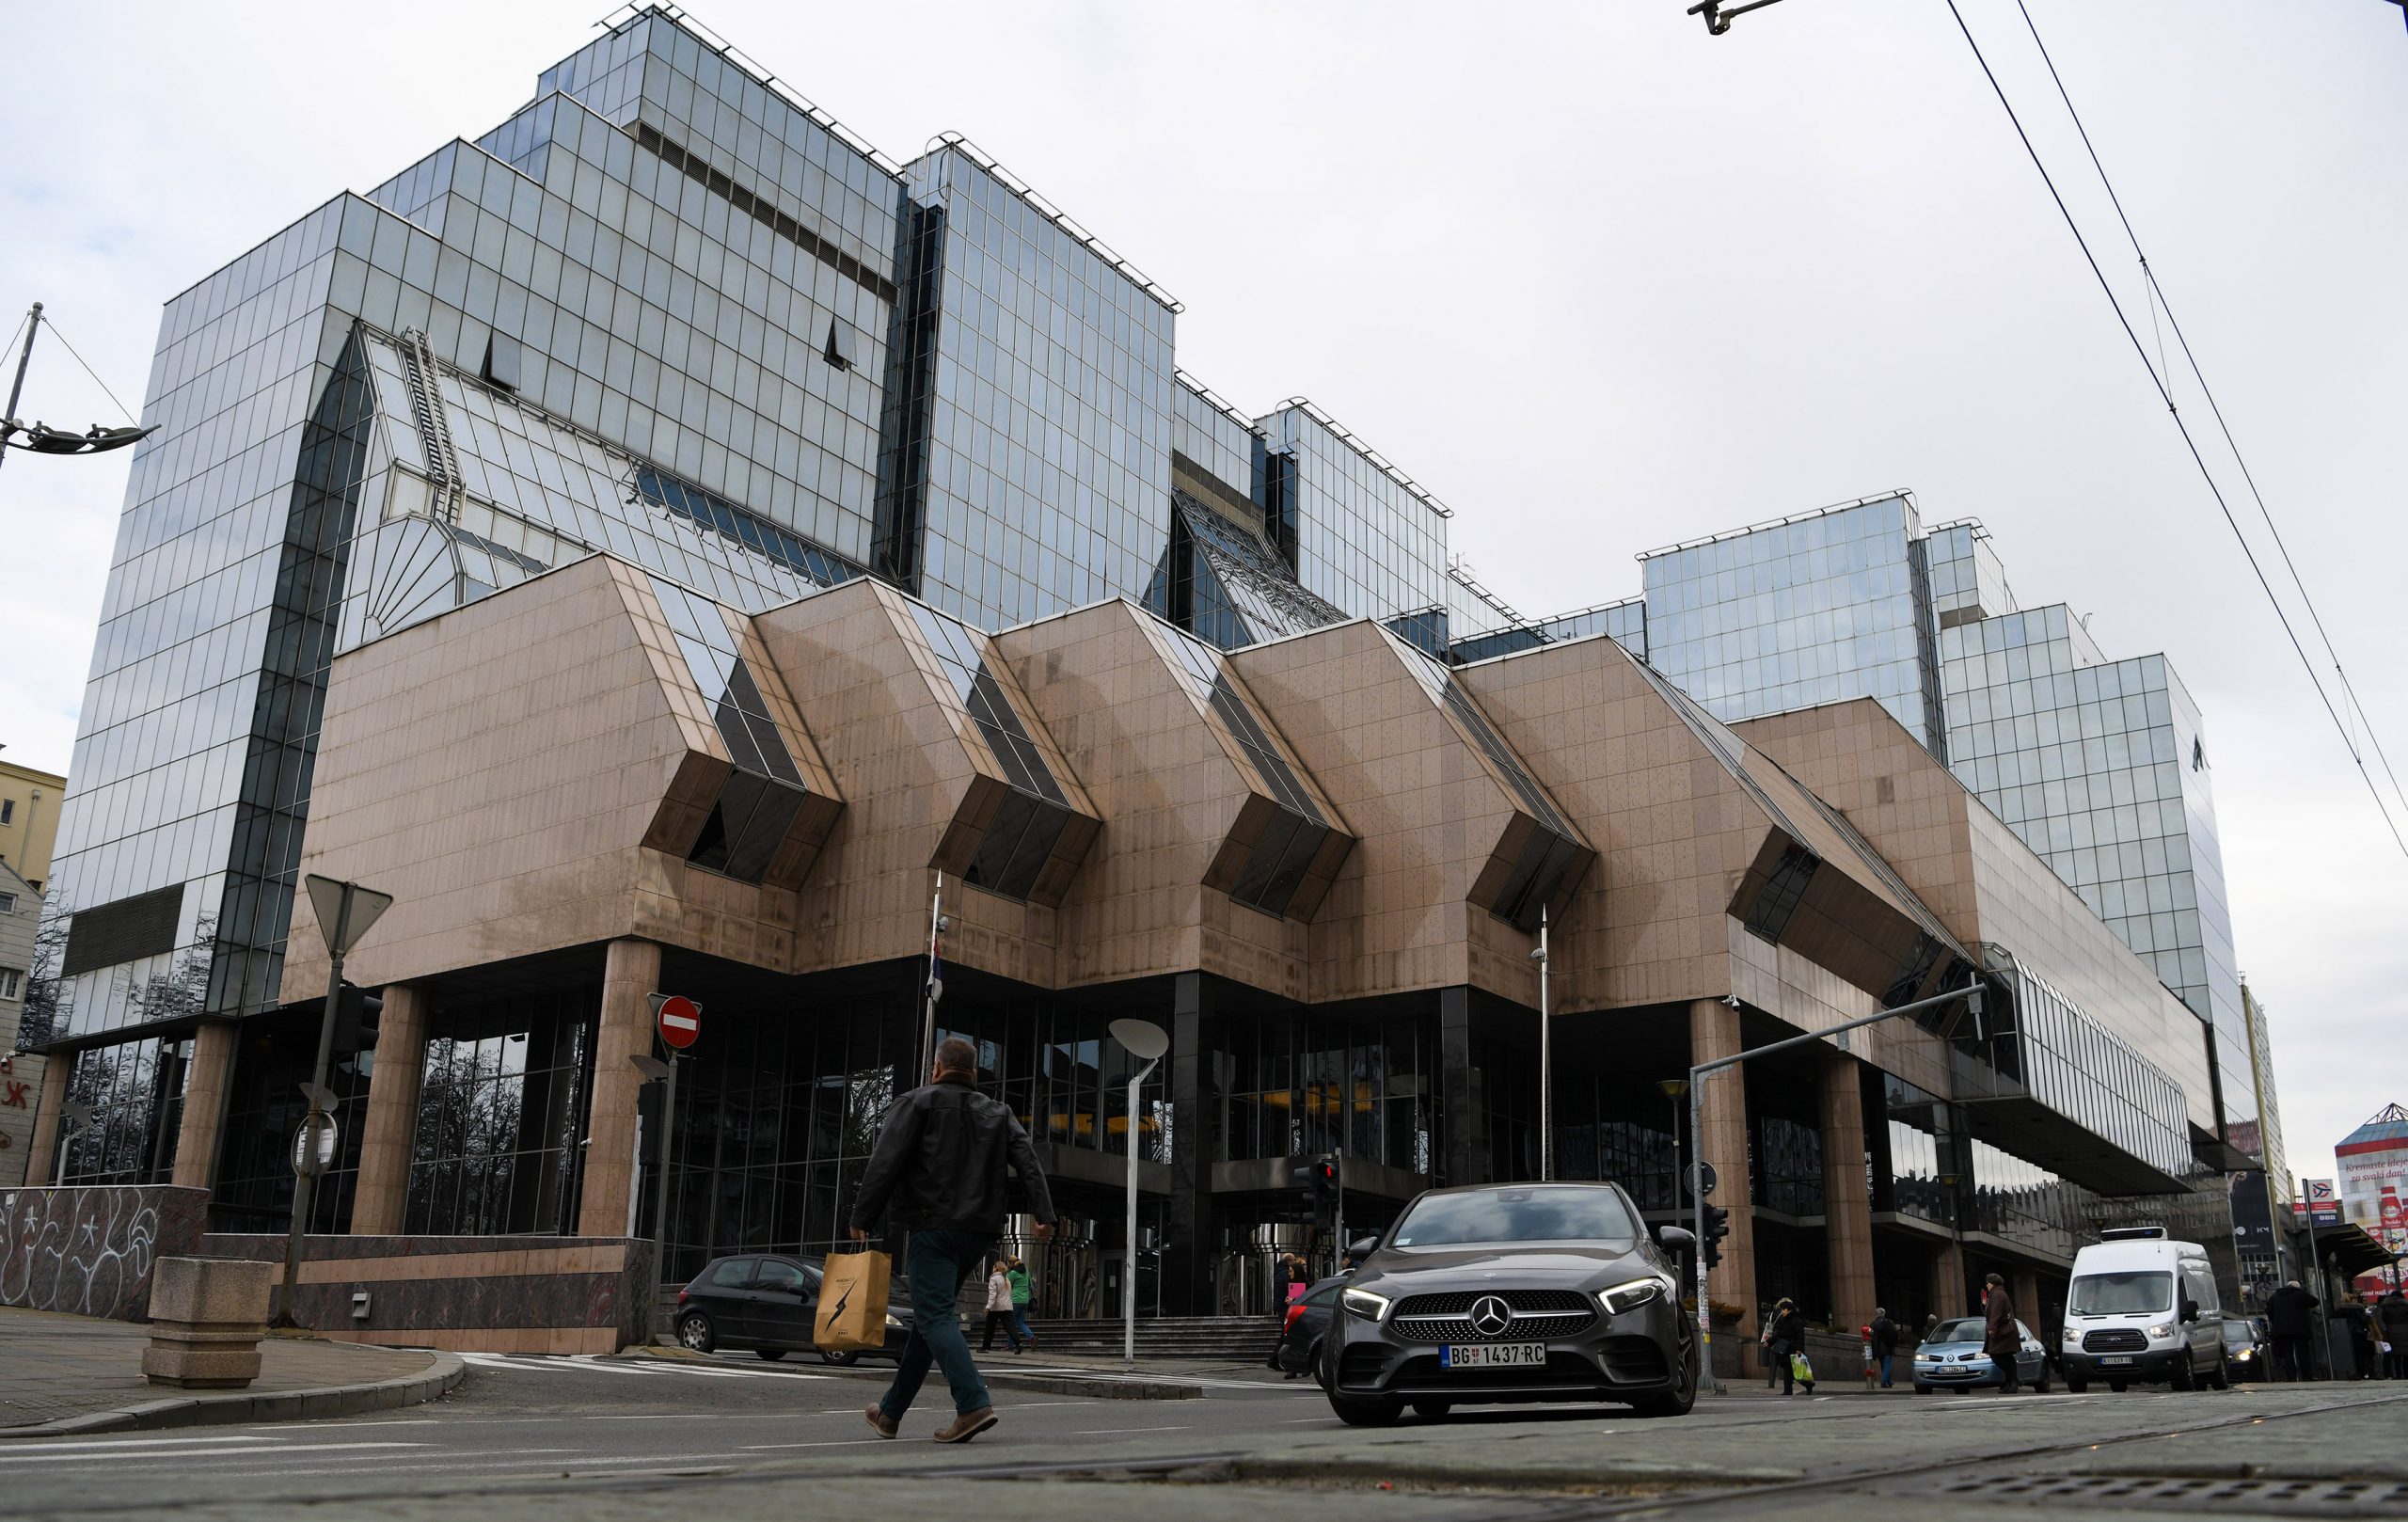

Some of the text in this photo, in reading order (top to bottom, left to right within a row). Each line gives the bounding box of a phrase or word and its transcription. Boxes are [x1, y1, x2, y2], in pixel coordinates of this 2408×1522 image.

[2346, 1160, 2385, 1172] Kremaste
[2362, 1171, 2384, 1181] svaki
[2385, 1168, 2405, 1179] dan!
[1451, 1347, 1470, 1365] BG
